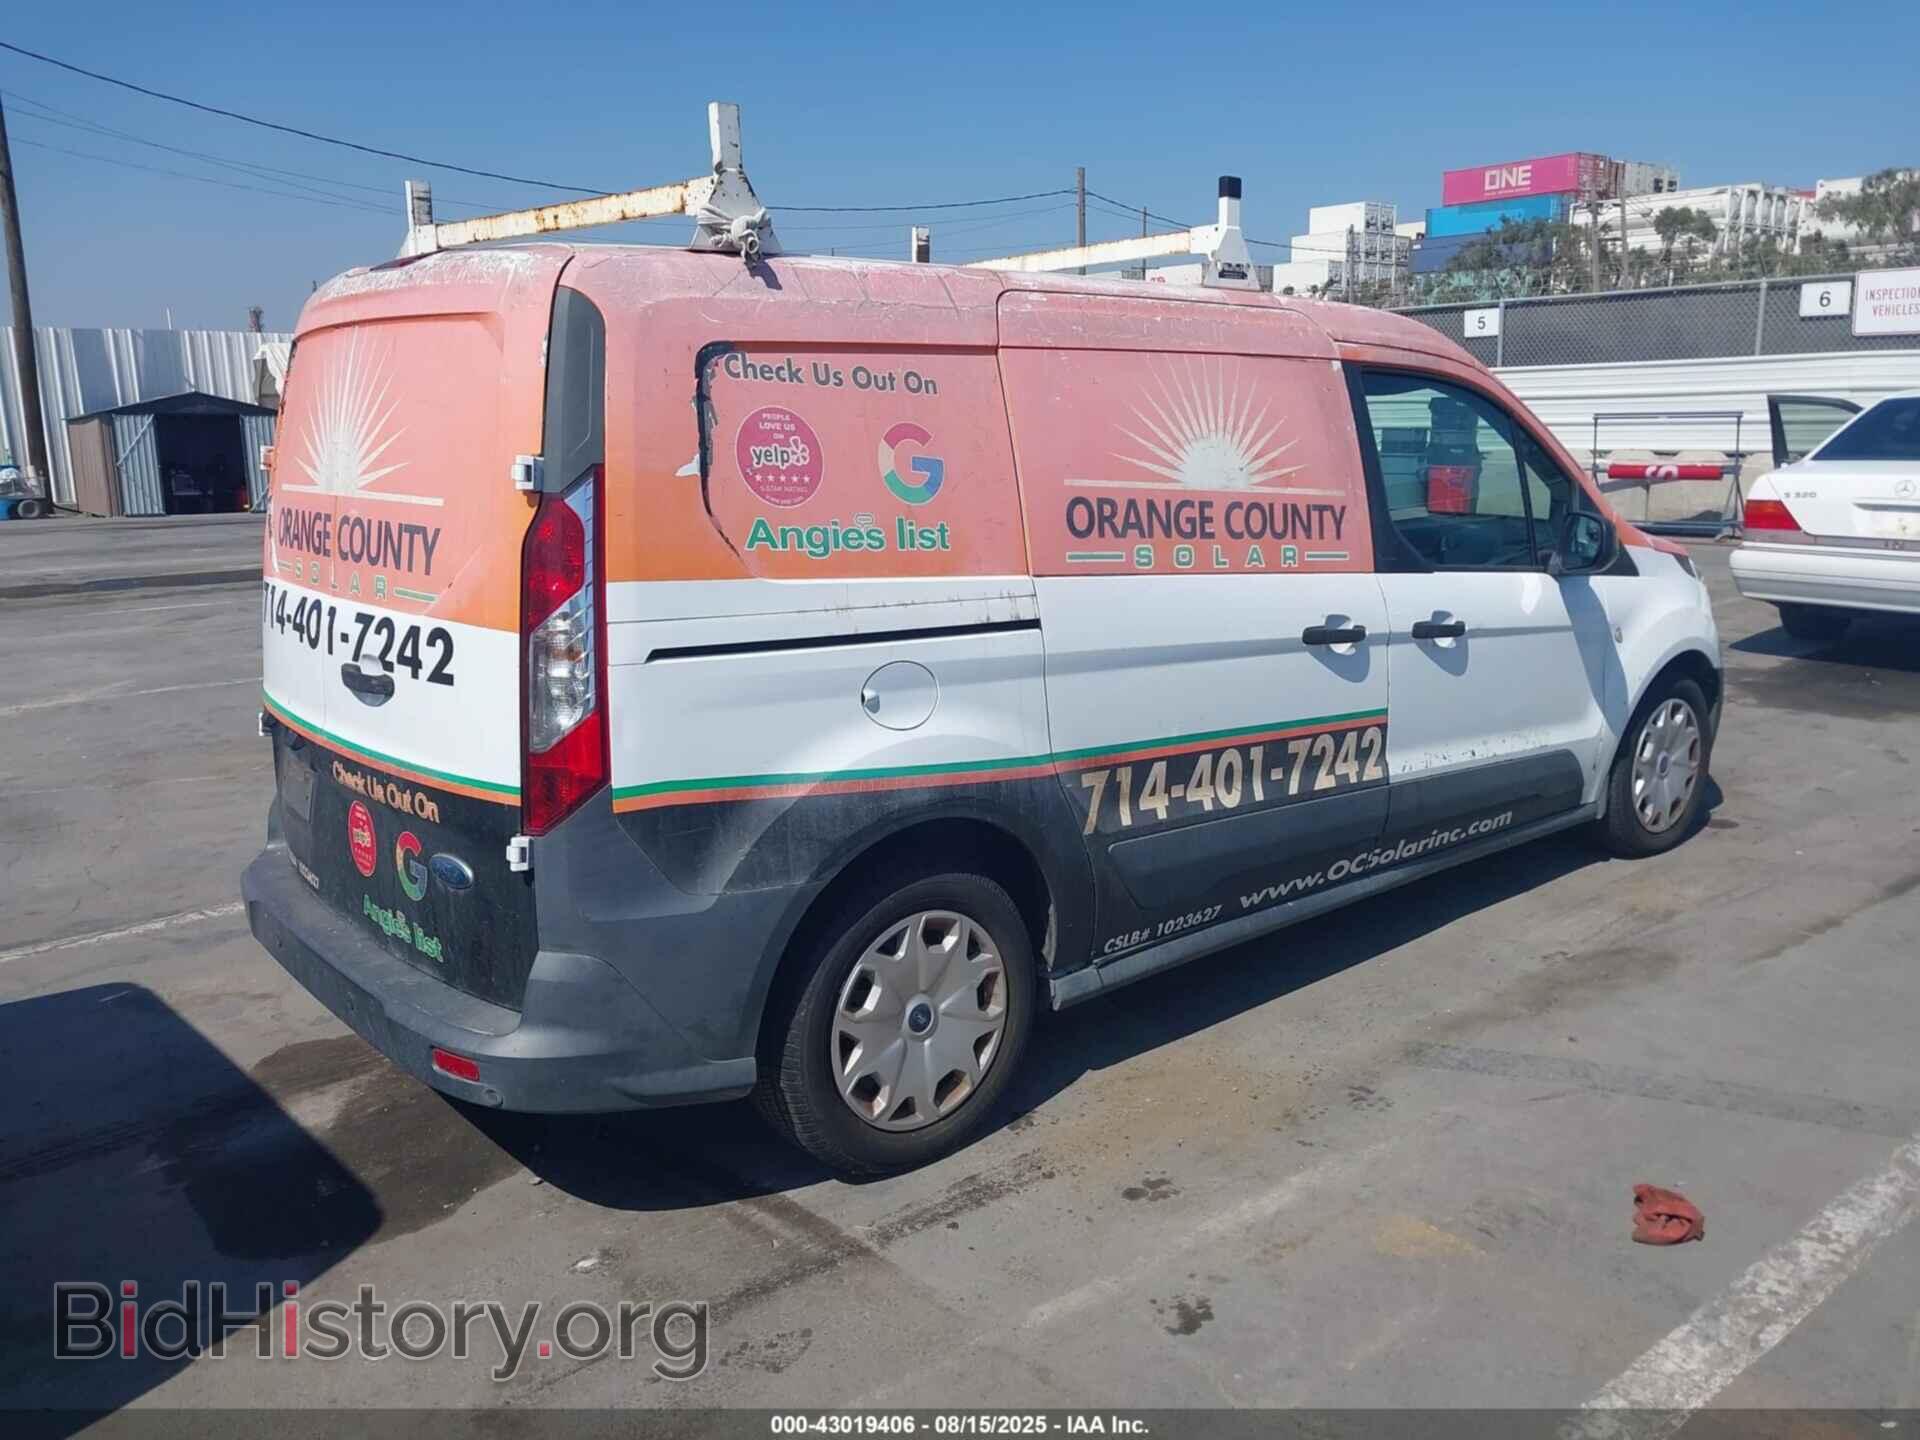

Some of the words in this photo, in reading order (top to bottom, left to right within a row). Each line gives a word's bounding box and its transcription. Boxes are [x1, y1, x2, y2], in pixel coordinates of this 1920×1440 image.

[1484, 164, 1532, 191] ONE
[1819, 290, 1831, 308] 6
[1872, 303, 1920, 317] VEHICLES
[1477, 316, 1486, 330] 5
[723, 353, 804, 384] Check
[811, 361, 845, 387] Us
[851, 365, 896, 392] Out
[903, 370, 939, 395] On
[759, 422, 782, 431] LOVE
[783, 424, 796, 432] US
[751, 445, 790, 468] yelp
[746, 517, 886, 559] Angies
[896, 516, 950, 552] list
[1065, 496, 1216, 540] ORANGE
[1224, 500, 1347, 541] COUNTY
[278, 506, 332, 558] ORANGE
[337, 514, 441, 576] COUNTY
[1133, 544, 1299, 569] SOLAR
[332, 760, 369, 798] Check
[386, 782, 415, 815] Out
[414, 792, 441, 824] On
[1081, 726, 1387, 835] 714-401-7242
[1239, 809, 1514, 909] www.OCSolarinc.com
[413, 921, 444, 963] list
[1103, 927, 1151, 954] CSLB#
[1156, 904, 1224, 938] 1023627
